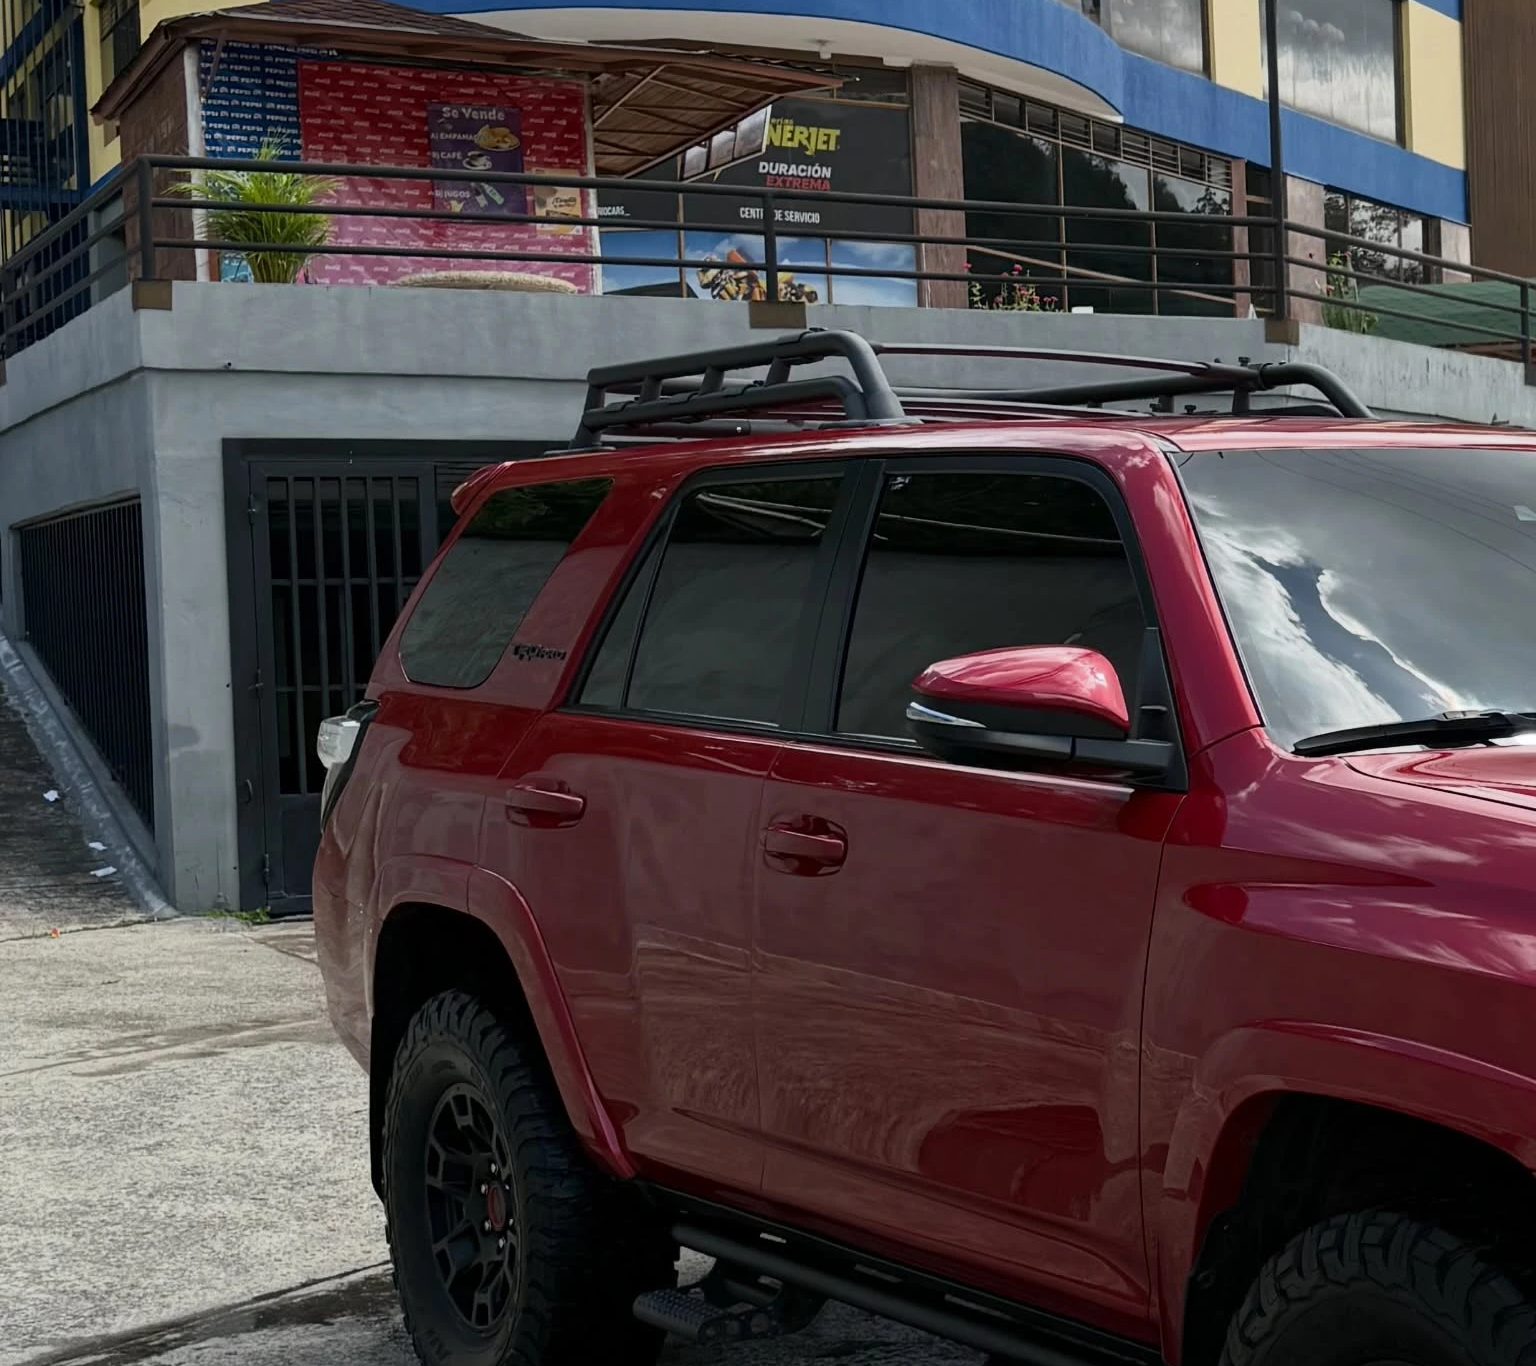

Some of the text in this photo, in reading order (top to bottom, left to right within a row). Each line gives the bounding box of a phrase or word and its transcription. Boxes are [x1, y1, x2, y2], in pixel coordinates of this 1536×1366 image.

[442, 106, 505, 121] Se Vende
[766, 123, 840, 156] NERJET
[758, 161, 832, 179] DURACIÓN
[765, 175, 831, 191] EXTREMA
[740, 207, 764, 219] CENT
[784, 211, 820, 224] SERVICIO
